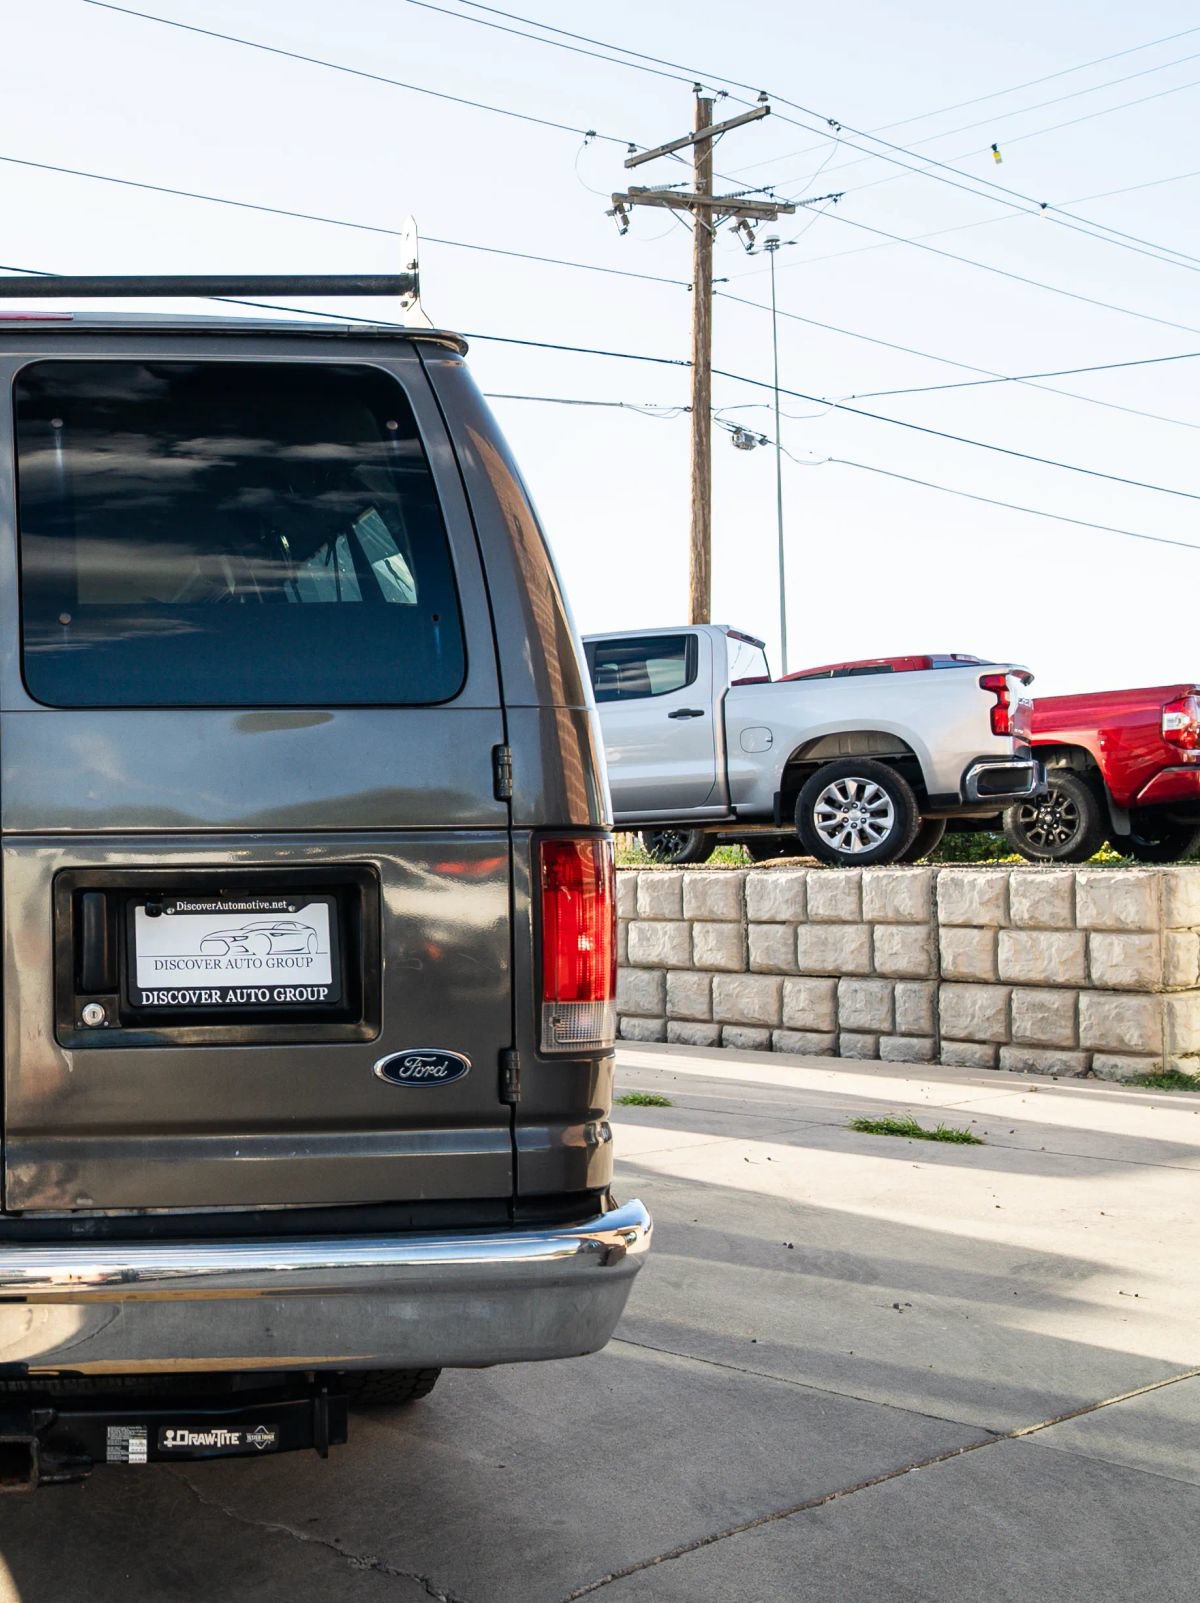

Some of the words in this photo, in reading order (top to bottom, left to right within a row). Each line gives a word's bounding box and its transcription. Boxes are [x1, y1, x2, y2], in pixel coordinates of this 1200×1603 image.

[176, 899, 288, 912] DiscoverAutomotive.net
[154, 958, 221, 971] DISCOVER
[225, 957, 263, 970] AUTO
[266, 956, 314, 969] GROUP
[141, 989, 224, 1005] DISCOVER
[227, 988, 270, 1003] AUTO
[273, 986, 329, 1002] GROUP
[398, 1056, 449, 1078] Ford
